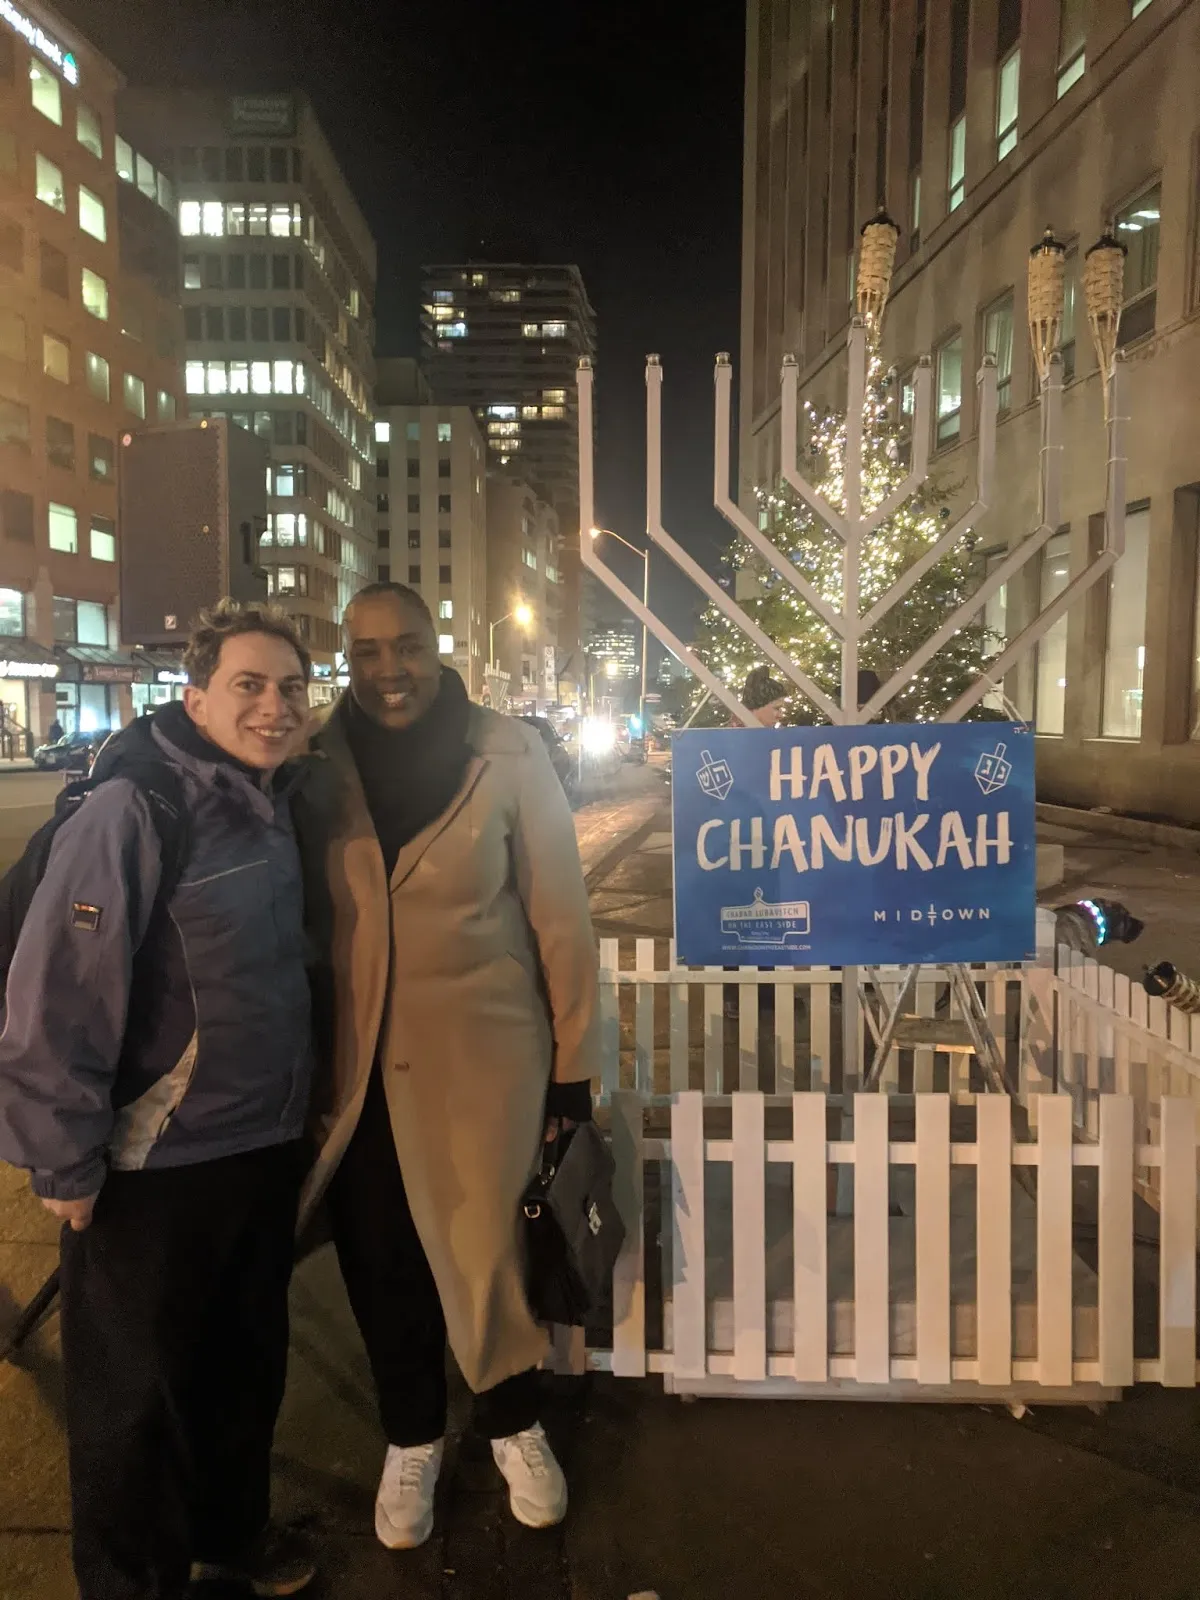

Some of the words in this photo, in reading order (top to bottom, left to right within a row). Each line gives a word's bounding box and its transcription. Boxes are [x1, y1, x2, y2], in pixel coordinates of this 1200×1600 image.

[769, 741, 941, 802] HAPPY
[696, 811, 1014, 873] CHANUKAH
[726, 909, 753, 918] CHABAD
[755, 907, 799, 918] LUBAVITCH
[874, 903, 990, 926] MIDTOWN
[740, 921, 751, 929] THE
[755, 921, 773, 929] EAST
[778, 920, 797, 928] SIDE
